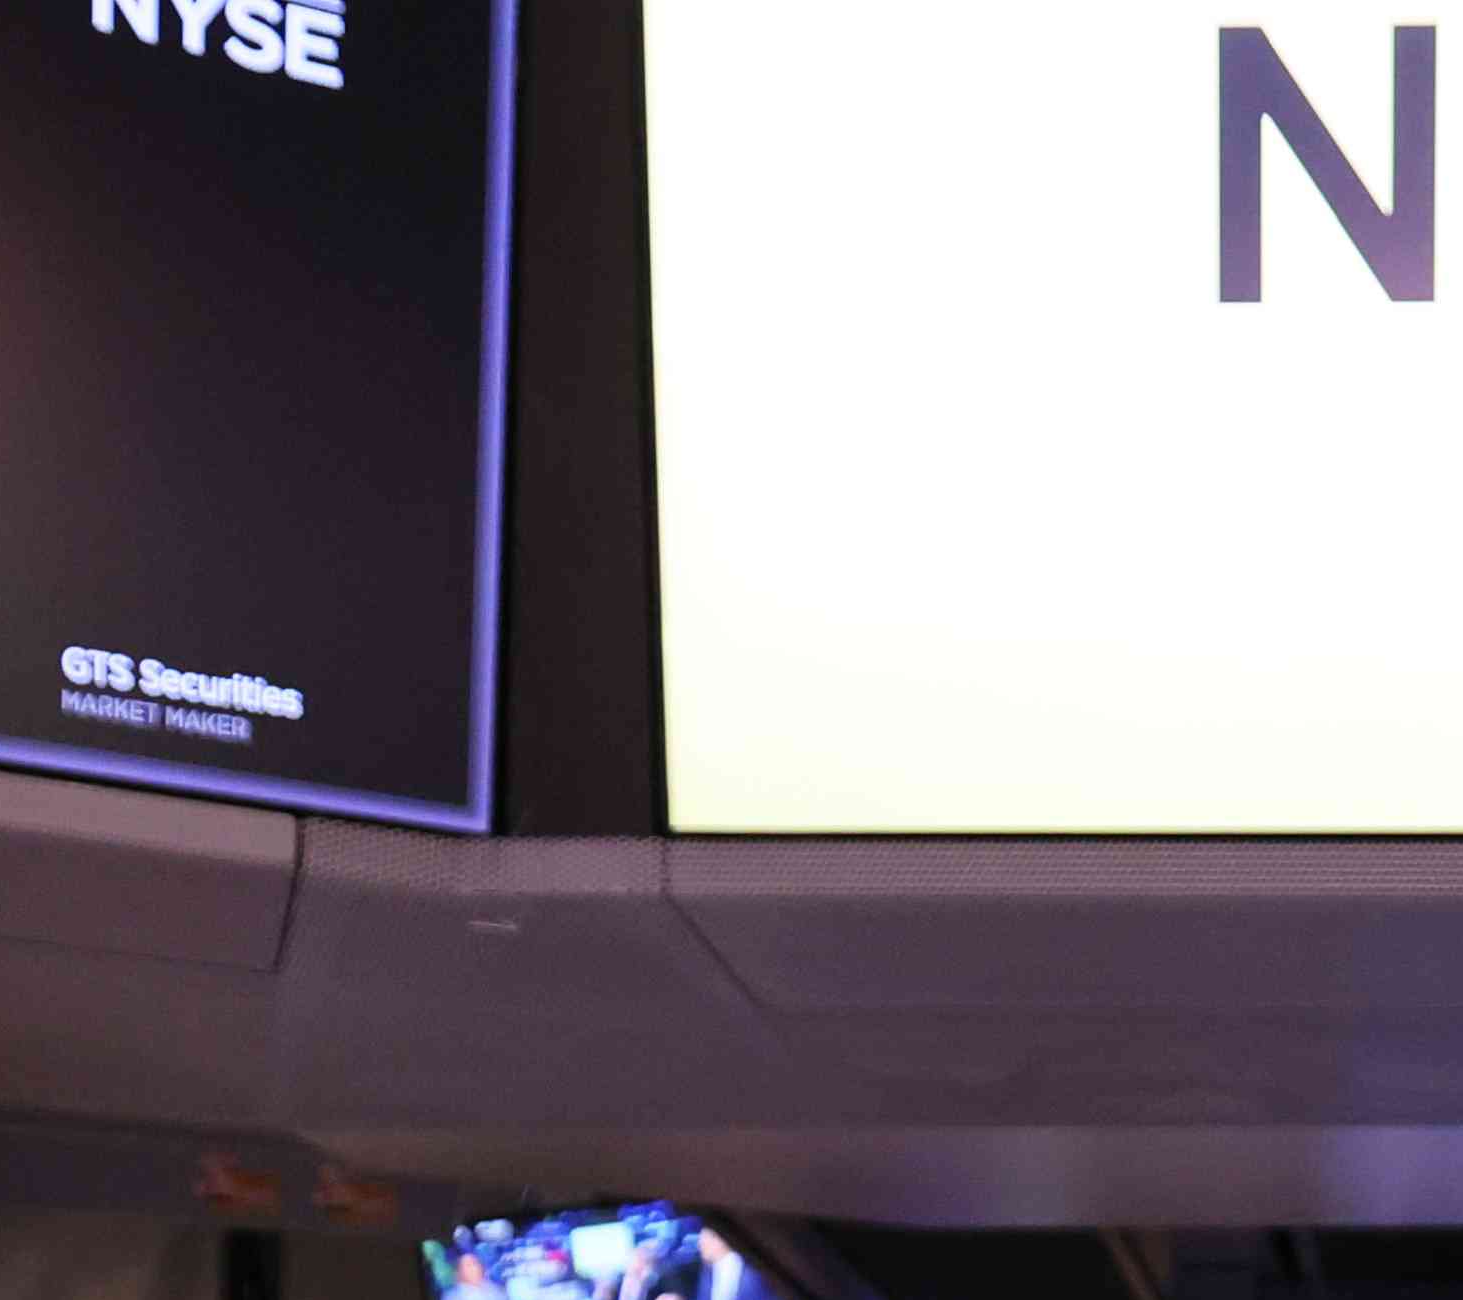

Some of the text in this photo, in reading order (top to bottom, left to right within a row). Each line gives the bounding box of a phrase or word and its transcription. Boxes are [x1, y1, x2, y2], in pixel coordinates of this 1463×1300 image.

[60, 645, 305, 720] GTS Securities
[60, 688, 255, 745] MARKET MAKER
